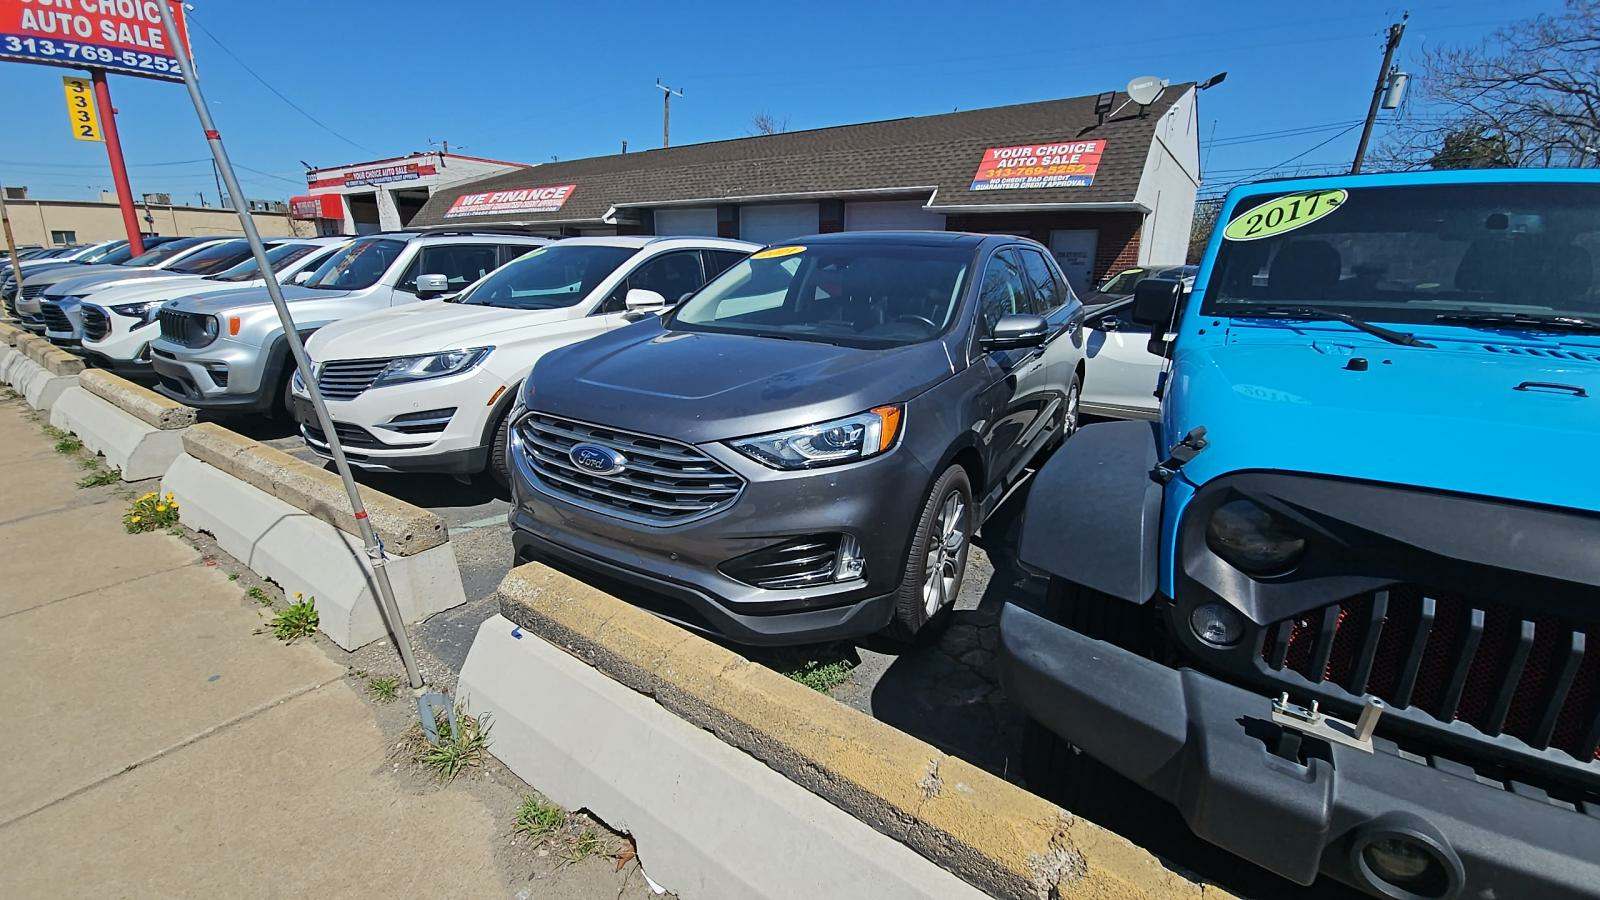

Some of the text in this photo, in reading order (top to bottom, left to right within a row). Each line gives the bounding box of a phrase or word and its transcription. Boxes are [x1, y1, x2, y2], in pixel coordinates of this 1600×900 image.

[80, 0, 177, 25] CHOIC
[21, 8, 165, 49] AUTO SALE
[5, 36, 182, 73] 313-769-5252
[71, 80, 94, 137] 3332
[992, 142, 1096, 159] YOUR CHOICE
[985, 164, 1086, 178] 313-769-5252
[997, 154, 1080, 168] AUTO SALE
[366, 169, 382, 179] CHOICE
[382, 167, 395, 177] AUTO
[395, 165, 408, 175] SALE
[1043, 174, 1071, 182] CREDIT
[1046, 179, 1086, 188] APPROVAL
[462, 186, 570, 206] WE FINANCE
[1245, 192, 1321, 237] 2017
[578, 449, 605, 469] Ford
